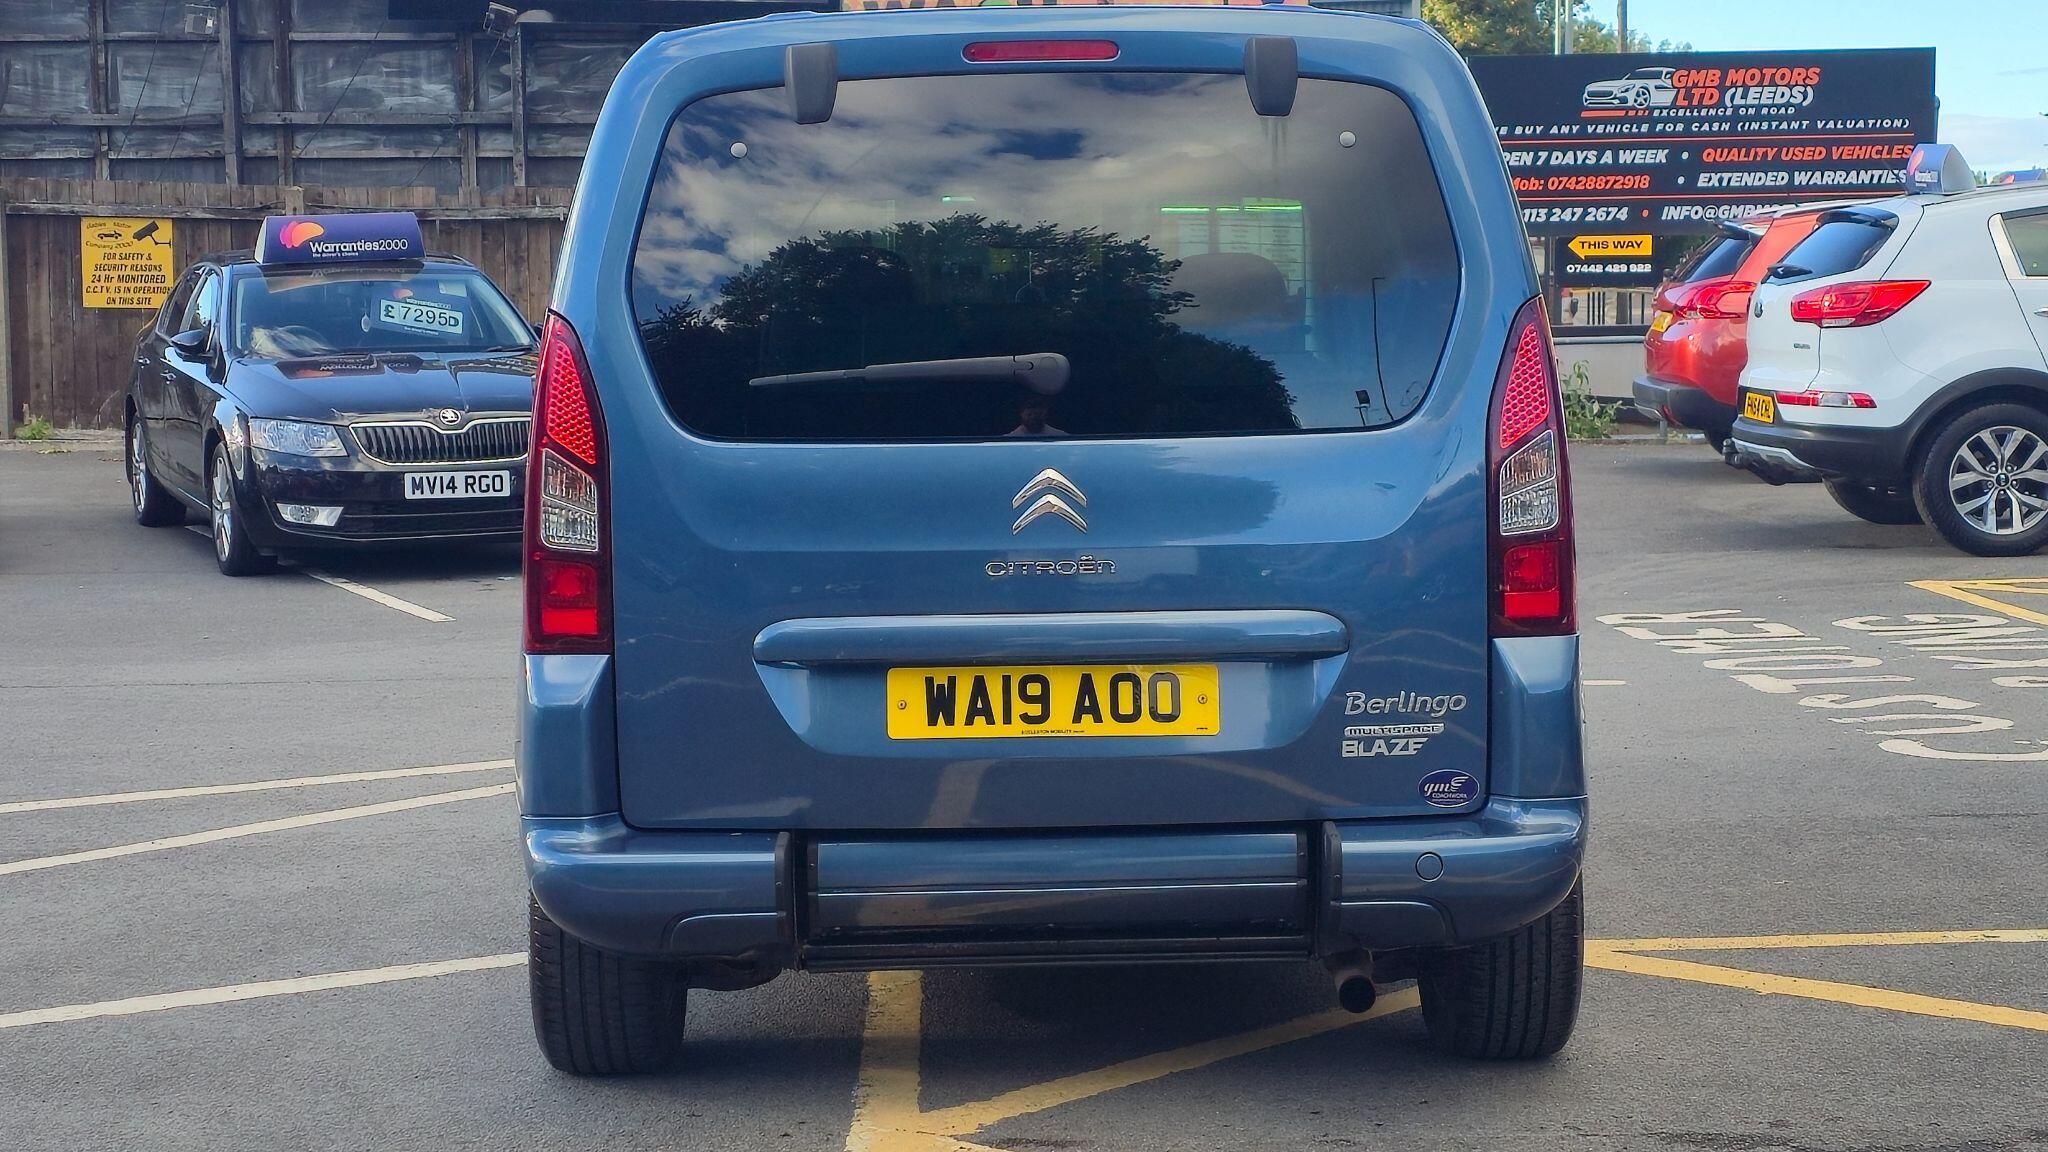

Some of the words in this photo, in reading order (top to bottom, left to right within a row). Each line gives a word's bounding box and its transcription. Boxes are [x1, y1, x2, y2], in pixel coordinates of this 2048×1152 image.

[1672, 69, 1720, 88] GMB
[1725, 67, 1821, 87] MOTORS
[1675, 89, 1719, 107] LTD
[1724, 86, 1814, 107] (LEEDS)
[1652, 108, 1733, 117] EXCELLENCE
[1739, 107, 1756, 115] ON
[1761, 106, 1796, 115] ROAD
[1514, 125, 1544, 134] BUY
[1549, 125, 1580, 134] ANY
[1587, 123, 1650, 133] VEHICLE
[1655, 122, 1685, 132] FOR
[1691, 122, 1731, 132] CASH
[1737, 120, 1810, 131] (INSTANT
[1816, 118, 1910, 129] VALUATION)
[1503, 151, 1535, 166] PEN
[1536, 151, 1549, 165] 7
[1549, 150, 1598, 165] DAYS
[1599, 150, 1615, 164] A
[1619, 149, 1669, 164] WEEK
[1702, 148, 1777, 162] QUALITY
[1780, 146, 1827, 161] USED
[1831, 144, 1914, 160] VEHICLES
[1547, 175, 1650, 191] 07428872918
[1697, 171, 1789, 187] EXTENDED
[1793, 169, 1907, 185] WARRANTIES
[1549, 207, 1584, 222] 247
[1585, 206, 1629, 222] 2674
[309, 239, 408, 253] Warranties2000
[1579, 241, 1609, 249] THIS
[1613, 241, 1643, 249] WAY
[103, 253, 117, 261] FOR
[119, 252, 145, 261] SAFETY
[146, 253, 152, 261] &
[94, 263, 128, 272] SECURITY
[130, 264, 163, 272] REASONS
[91, 274, 102, 284] 24
[104, 275, 115, 283] Hr
[117, 275, 166, 284] MONITORED
[114, 286, 122, 294] IS
[106, 297, 116, 305] ON
[119, 297, 134, 305] THIS
[136, 297, 152, 305] SITE
[411, 475, 458, 495] MV14
[464, 475, 504, 493] RGO
[924, 673, 1051, 727] WA19
[1344, 690, 1467, 718] Berlingo
[1348, 725, 1442, 736] MULTISPACE
[1341, 737, 1429, 758] BLAZE
